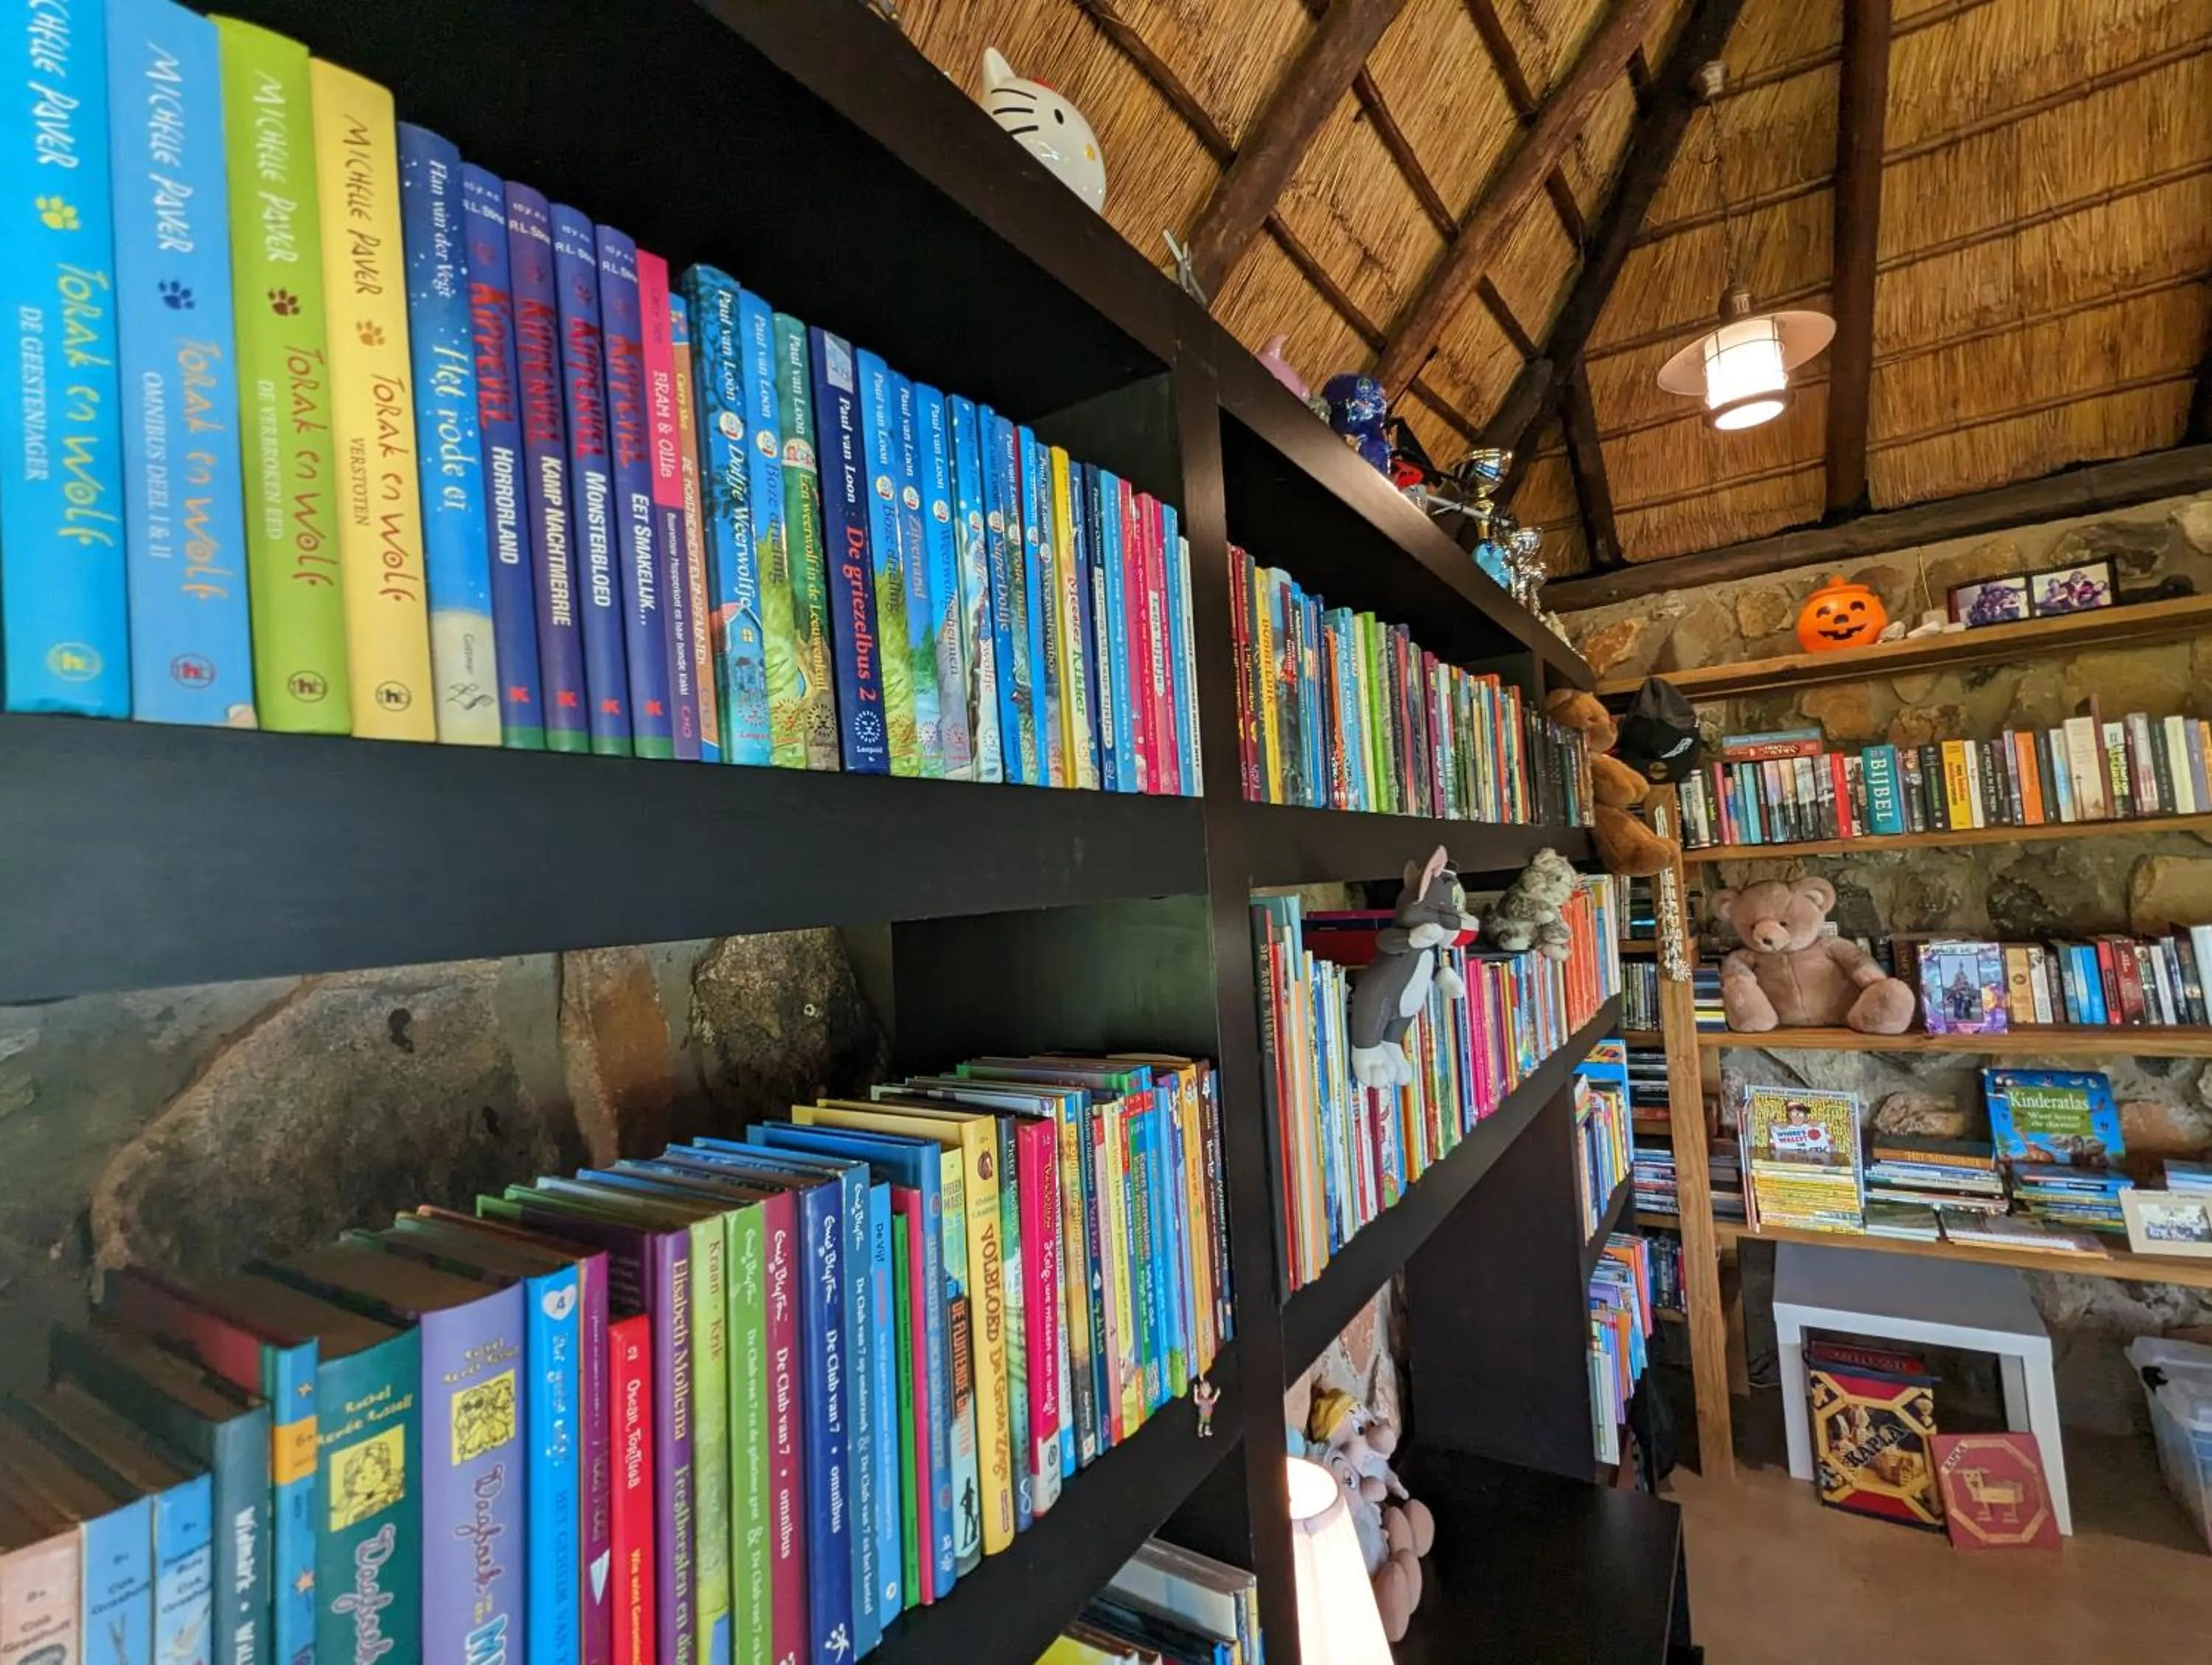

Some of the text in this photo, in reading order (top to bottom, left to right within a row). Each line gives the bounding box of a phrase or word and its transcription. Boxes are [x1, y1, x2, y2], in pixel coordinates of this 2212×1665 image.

[27, 0, 80, 169] CHELLE PAVER
[145, 43, 194, 253] MICHELLE PAVER
[253, 69, 299, 263] MICHELLE PAVER
[342, 114, 383, 296] MICHELLE PAVER
[434, 232, 453, 261] der
[718, 289, 737, 401] Paul van Loon
[754, 314, 773, 419] Paul van Loon
[789, 333, 806, 435] Paul van Loon
[19, 306, 49, 482] DE GEESTENJAGER
[653, 370, 670, 417] BRAM
[657, 420, 672, 435] &
[874, 372, 891, 465] Paul van Loon
[900, 387, 914, 478] Paul van Loon
[142, 371, 170, 509] OMNIBUS DEEL
[257, 380, 283, 540] DE VERBROKEN EED
[350, 437, 370, 526] VERSTOTEN
[437, 408, 476, 478] rode
[839, 397, 856, 503] Paul van Loon
[931, 403, 945, 490] Paul van Loon
[491, 445, 520, 564] HORRORLAND
[540, 456, 571, 627] KAMP NACHTMERRIE
[585, 471, 612, 607] MONSTERBLOED
[631, 493, 650, 523] EET
[726, 443, 753, 608] Dolfje Weerwolfje
[801, 501, 816, 562] weerwolf
[808, 585, 821, 602] de
[842, 524, 877, 702] De griezelbus 2
[1870, 757, 1893, 822] BIJBEL
[2008, 1091, 2090, 1110] Kinderatlas
[740, 1228, 757, 1265] Enid
[818, 1215, 838, 1304] Enid Blyton
[852, 1183, 865, 1251] Enid Blyton
[875, 1223, 885, 1262] De Vijf
[709, 1240, 721, 1296] Kraan
[768, 1229, 788, 1321] Enid Blyton
[952, 1302, 965, 1322] DE
[981, 1221, 1002, 1343] VOLBLOED
[746, 1329, 758, 1344] De
[747, 1348, 758, 1377] Club
[953, 1324, 969, 1394] FLUITENDE
[990, 1348, 1004, 1370] De
[1045, 1304, 1053, 1351] missen
[344, 1384, 392, 1415] Rachel
[748, 1379, 758, 1401] van
[825, 1330, 841, 1534] De Club van 7 omnibus
[856, 1277, 872, 1526] De Club van onderzoek De Club van
[672, 1259, 691, 1629] Elisabeth Mollema Feestbeesten en
[776, 1346, 793, 1559] De Club van 7 omnibus
[1845, 1423, 1906, 1467] KAPLA
[555, 1490, 569, 1651] HET GEHEIM VAN
[630, 1549, 641, 1605] Wie wint
